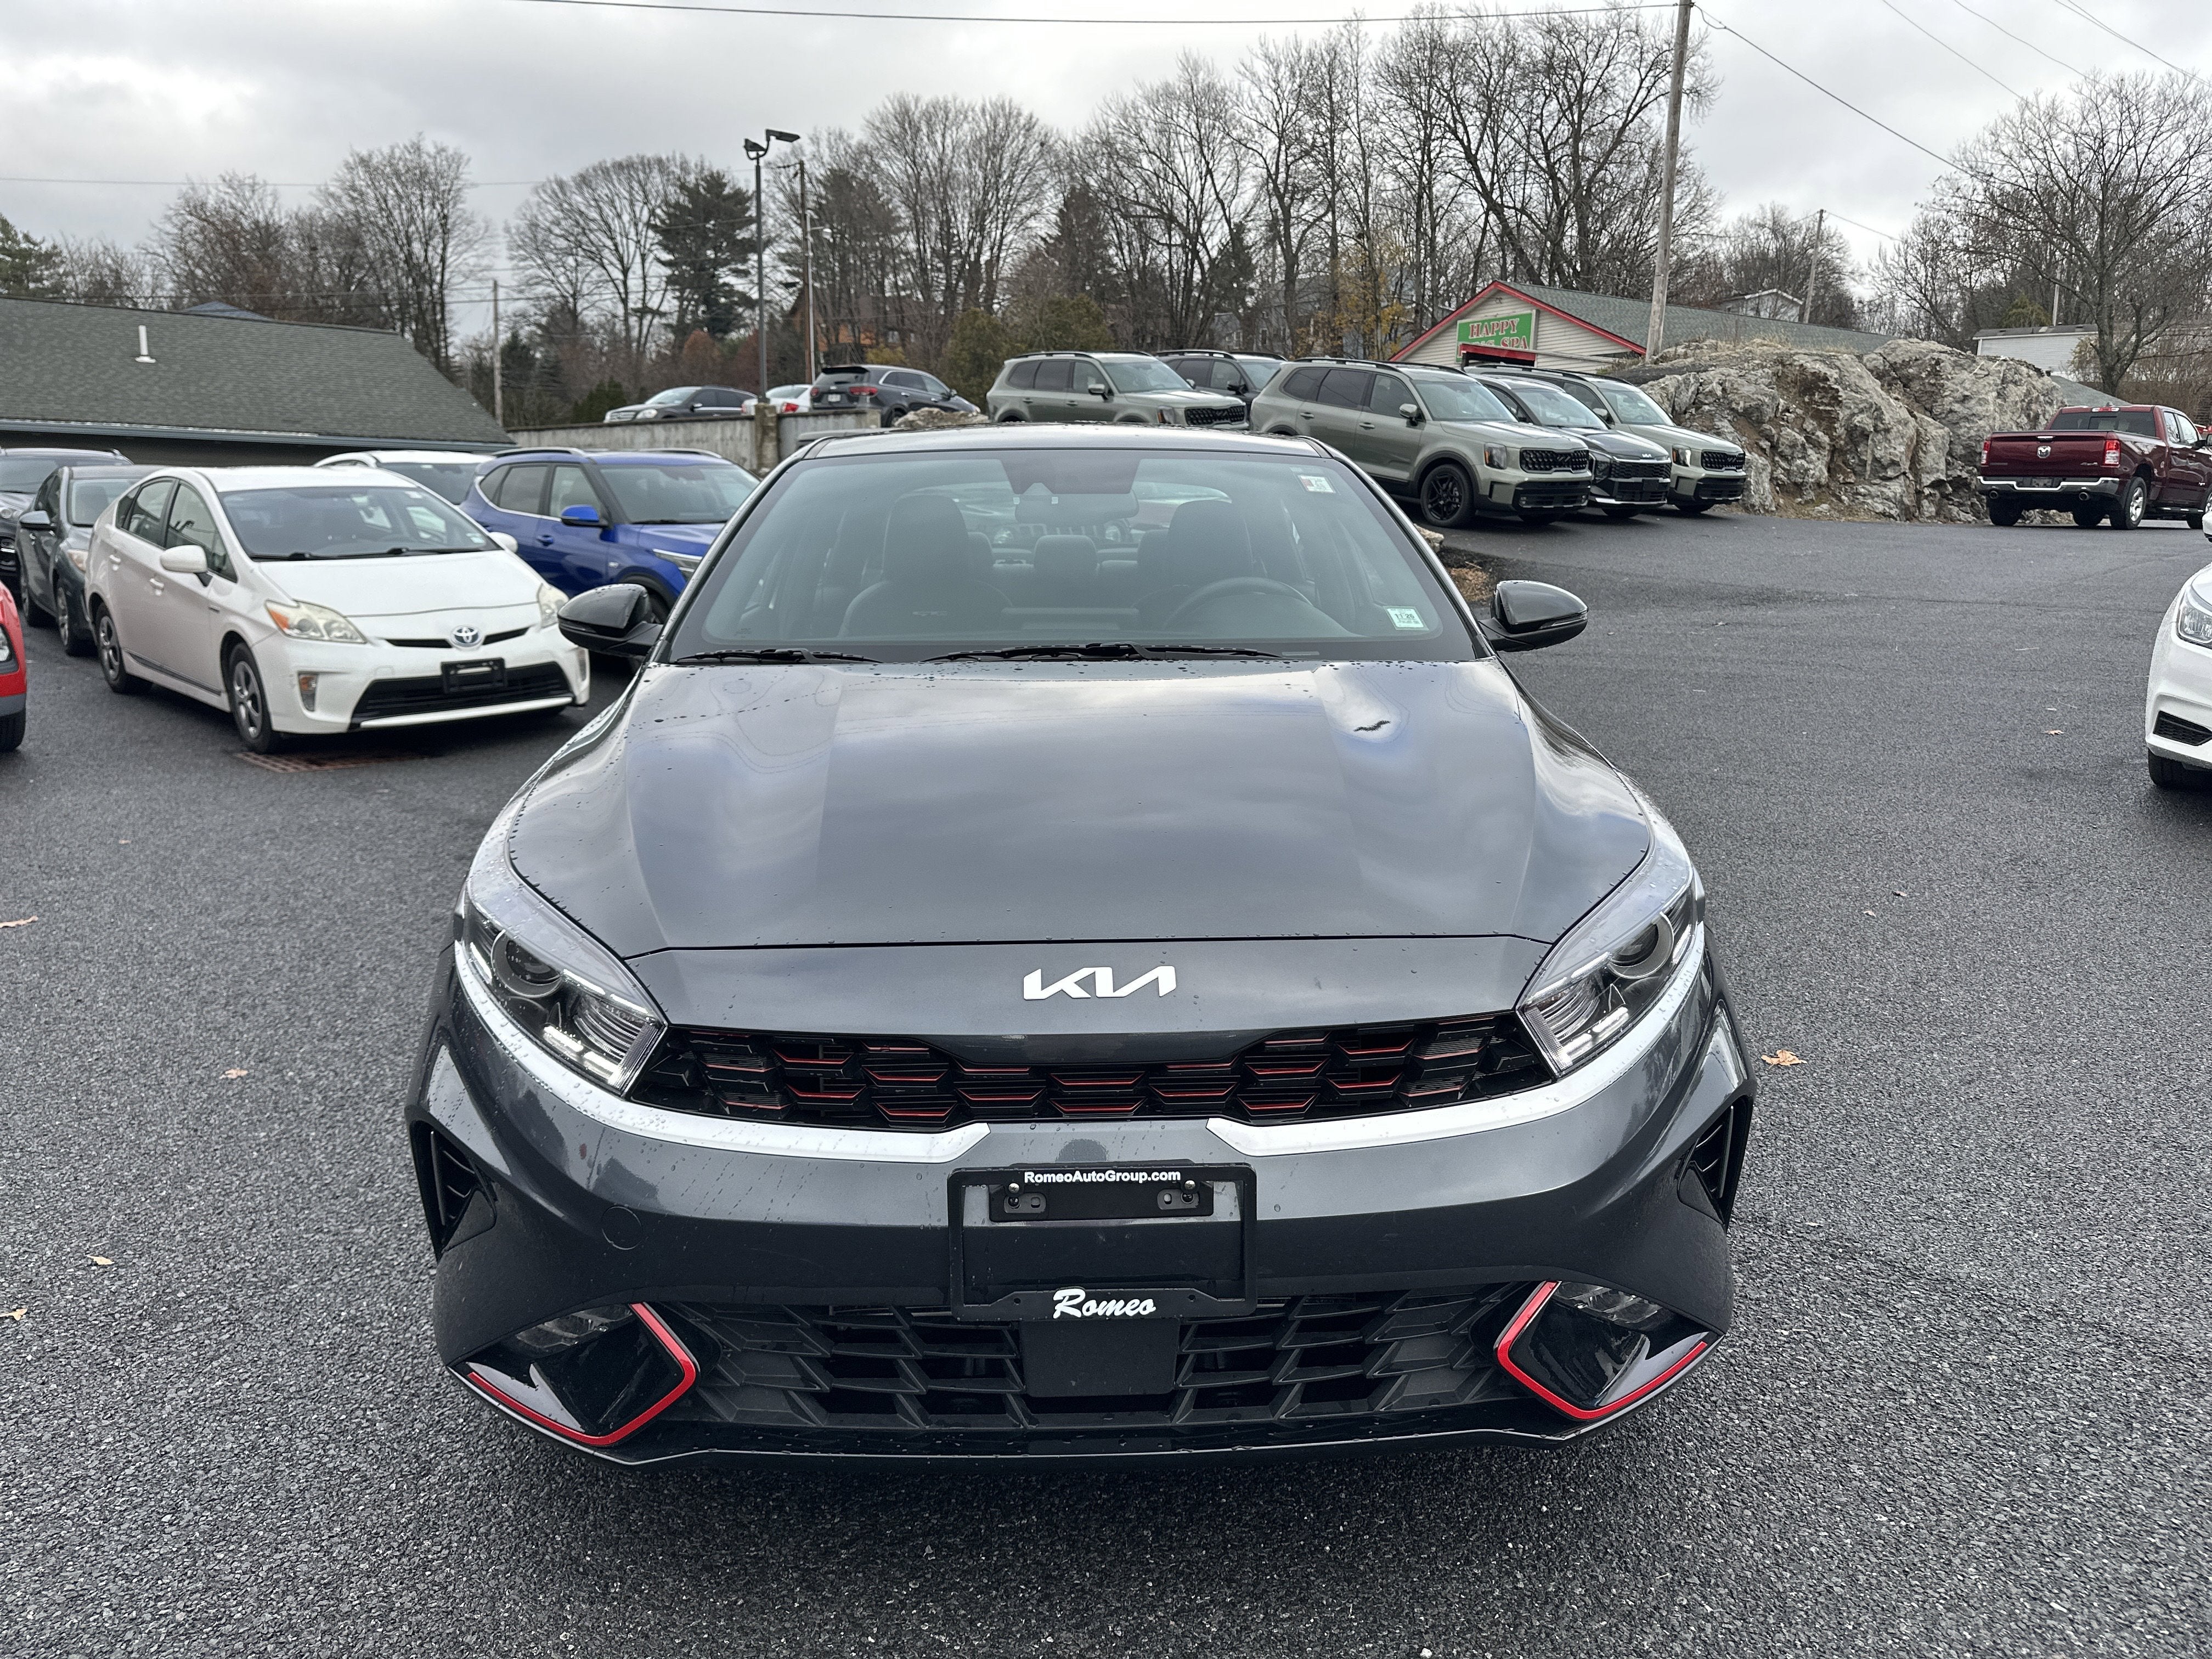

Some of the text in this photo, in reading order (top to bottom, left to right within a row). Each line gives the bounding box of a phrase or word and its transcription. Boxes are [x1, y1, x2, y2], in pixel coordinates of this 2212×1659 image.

[1469, 318, 1520, 339] HAPPY
[1500, 335, 1528, 349] SPA
[1023, 966, 1176, 1000] KIA
[1024, 1170, 1181, 1183] RomeoAutoGroup.com
[1053, 1289, 1156, 1319] Romeo
